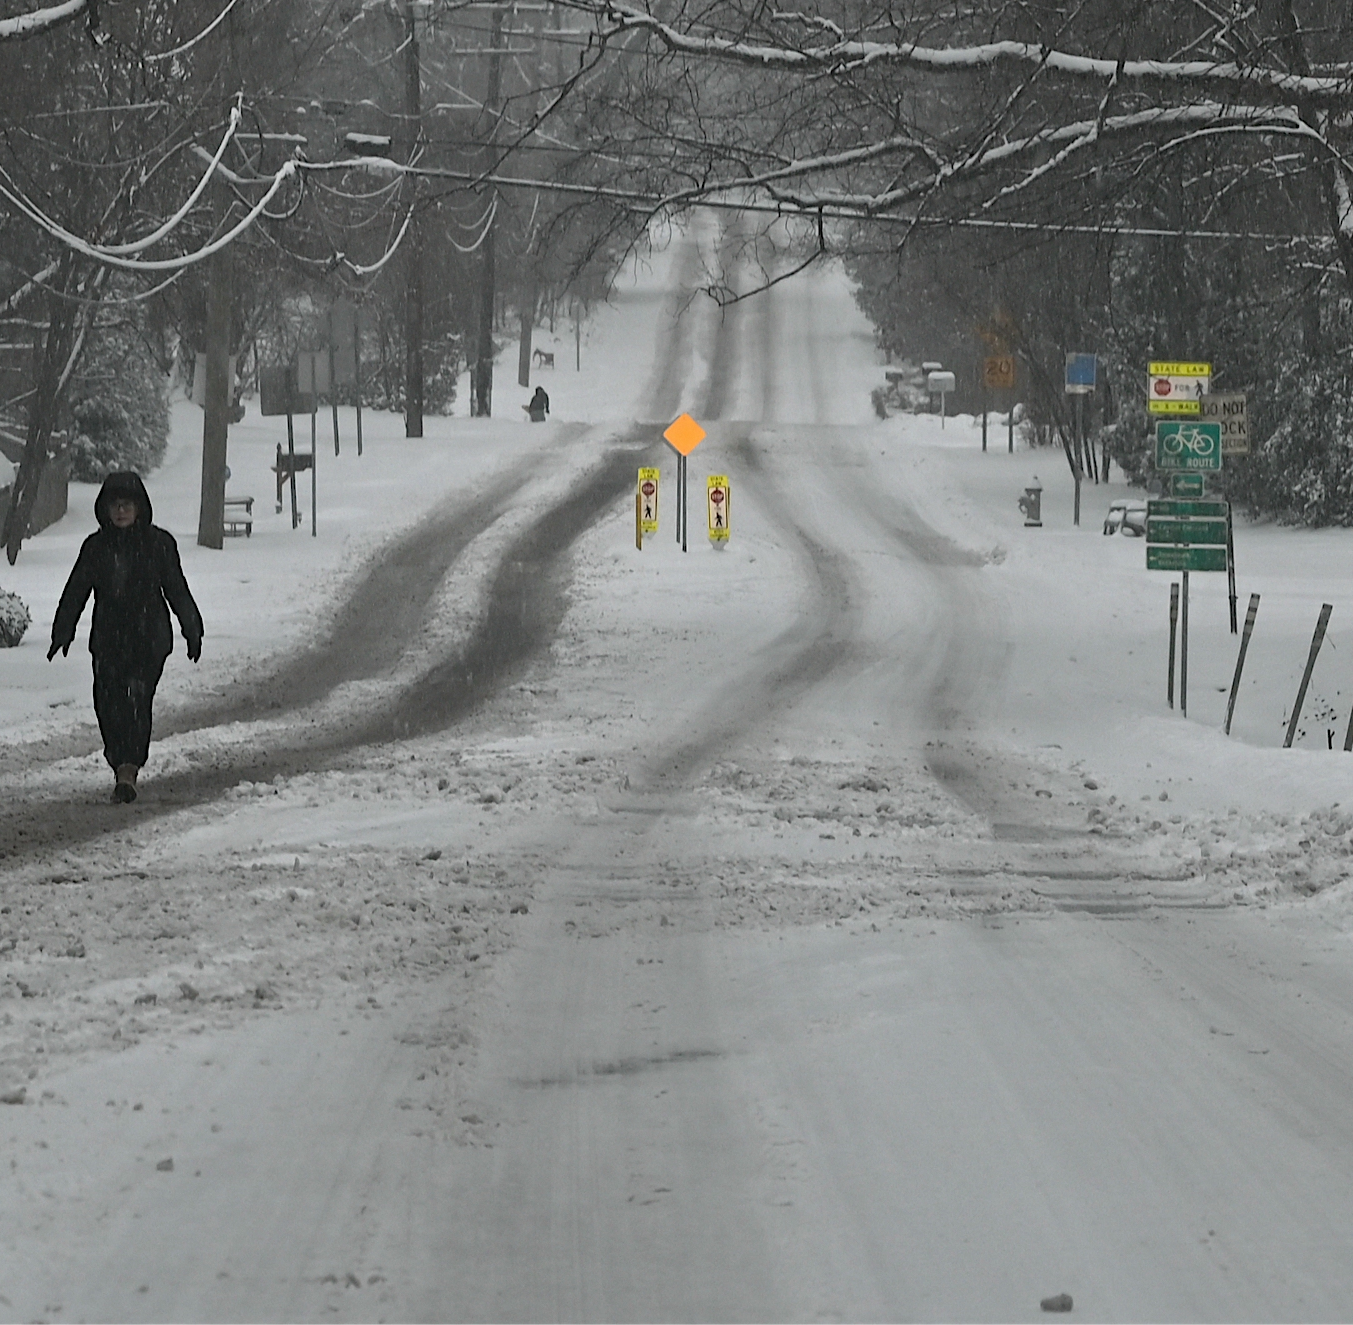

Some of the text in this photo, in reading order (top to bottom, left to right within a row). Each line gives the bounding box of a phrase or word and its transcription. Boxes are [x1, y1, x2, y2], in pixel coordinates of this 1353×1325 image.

[987, 360, 1011, 375] 20
[1154, 363, 1205, 373] STATE LAW
[1174, 384, 1190, 392] FOR
[1202, 401, 1245, 416] DO NOT
[1221, 420, 1247, 435] OCK
[1187, 458, 1215, 468] ROUTE
